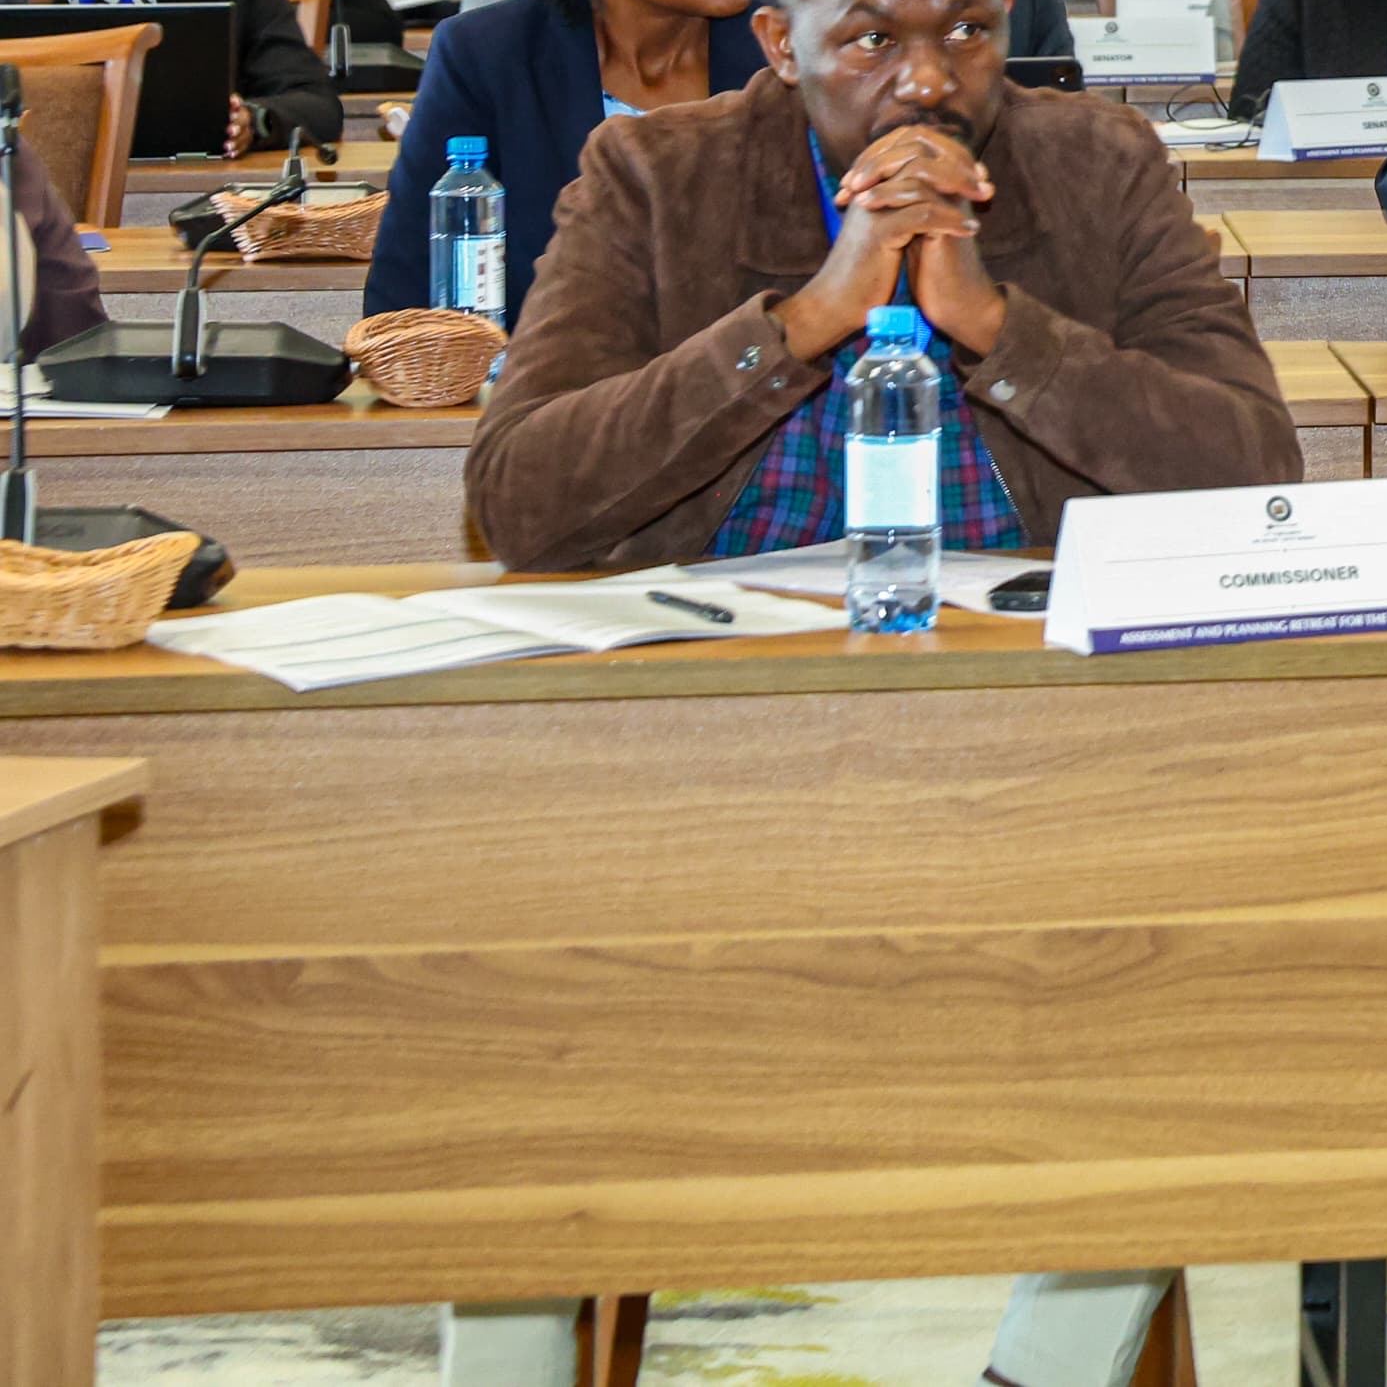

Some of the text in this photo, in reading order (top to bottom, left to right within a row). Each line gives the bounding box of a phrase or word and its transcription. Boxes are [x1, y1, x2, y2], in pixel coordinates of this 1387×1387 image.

[1219, 565, 1360, 589] COMMISSIONER
[1119, 626, 1195, 645] ASSESSMENT
[1193, 624, 1224, 639] AND
[1224, 620, 1288, 637] PLANNING
[1288, 616, 1337, 632] RETREAT
[1338, 614, 1364, 628] FOR
[1365, 612, 1387, 625] THE
